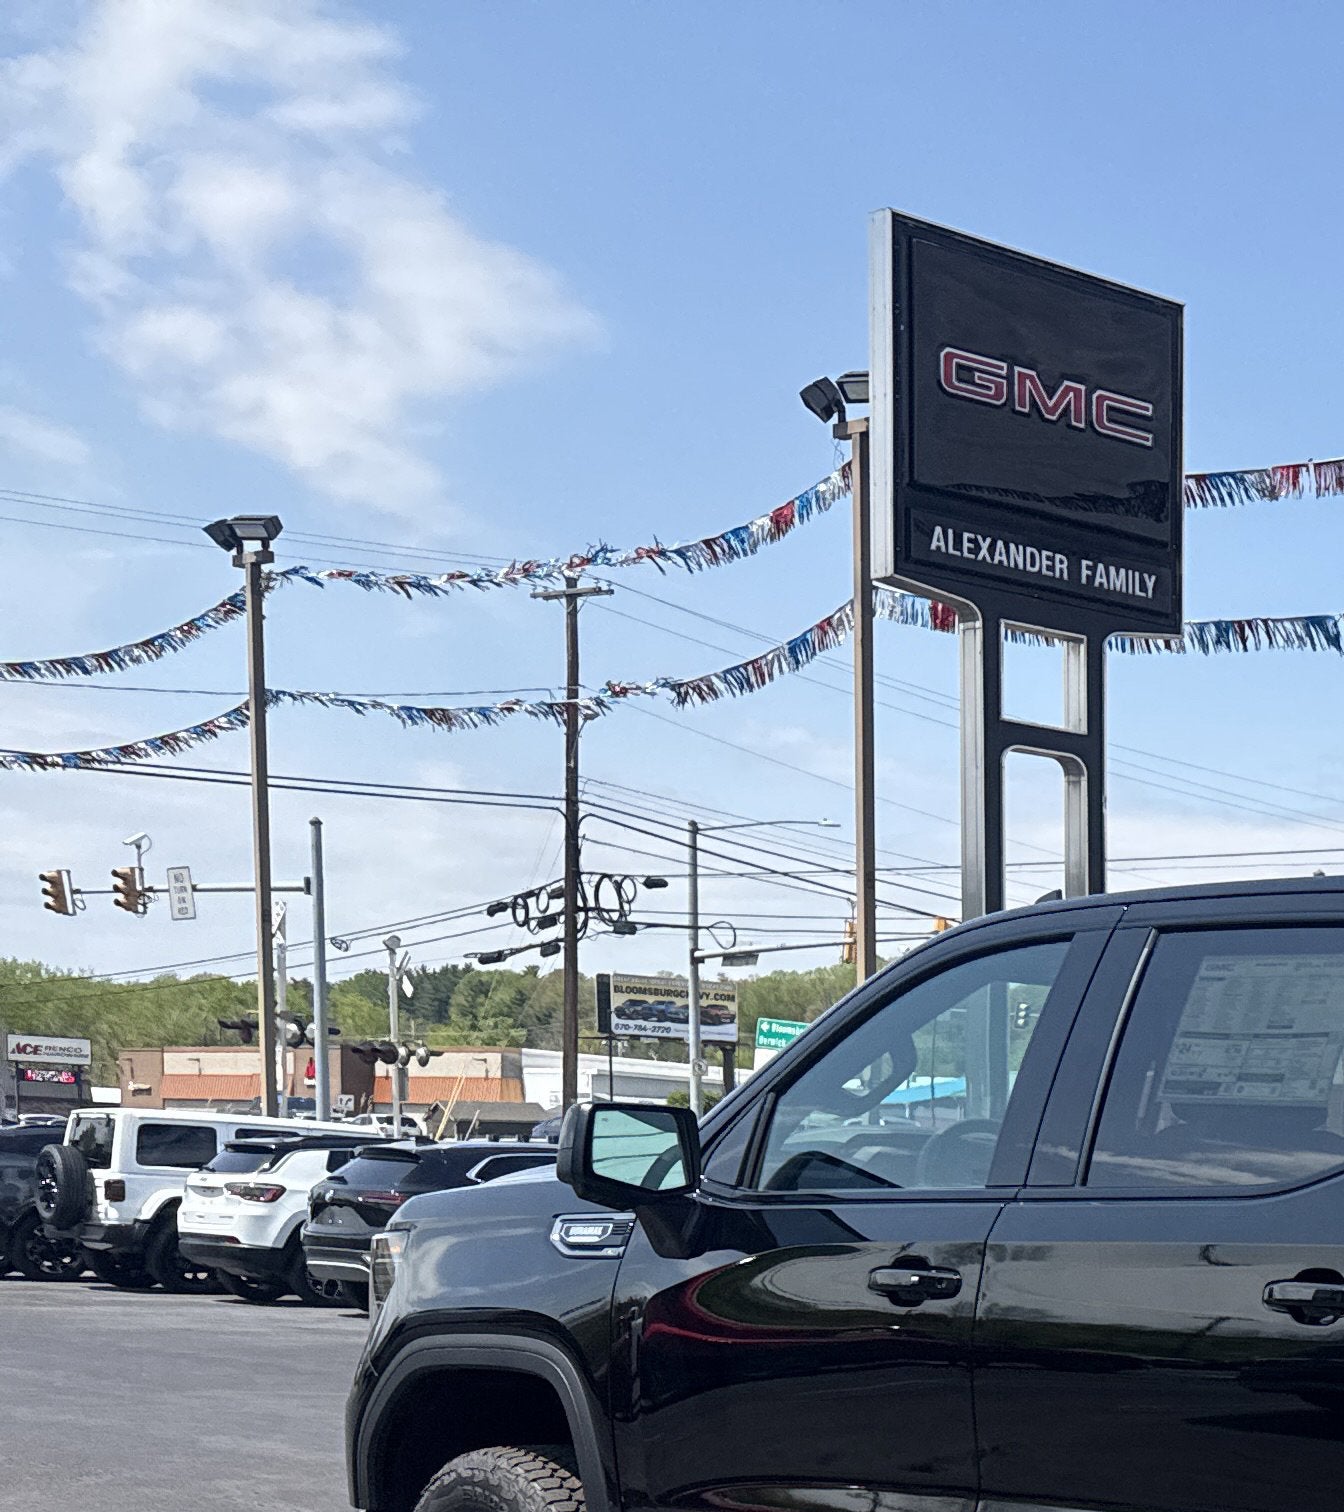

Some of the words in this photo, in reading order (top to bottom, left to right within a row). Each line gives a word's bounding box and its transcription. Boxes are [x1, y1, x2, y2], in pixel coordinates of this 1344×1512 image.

[940, 346, 1153, 447] GMC
[930, 525, 1069, 581] ALEXANDER
[1081, 559, 1158, 599] FAMILY
[613, 984, 736, 1003] BLOOMSBURGCVY.COM
[10, 1042, 43, 1056] ACE
